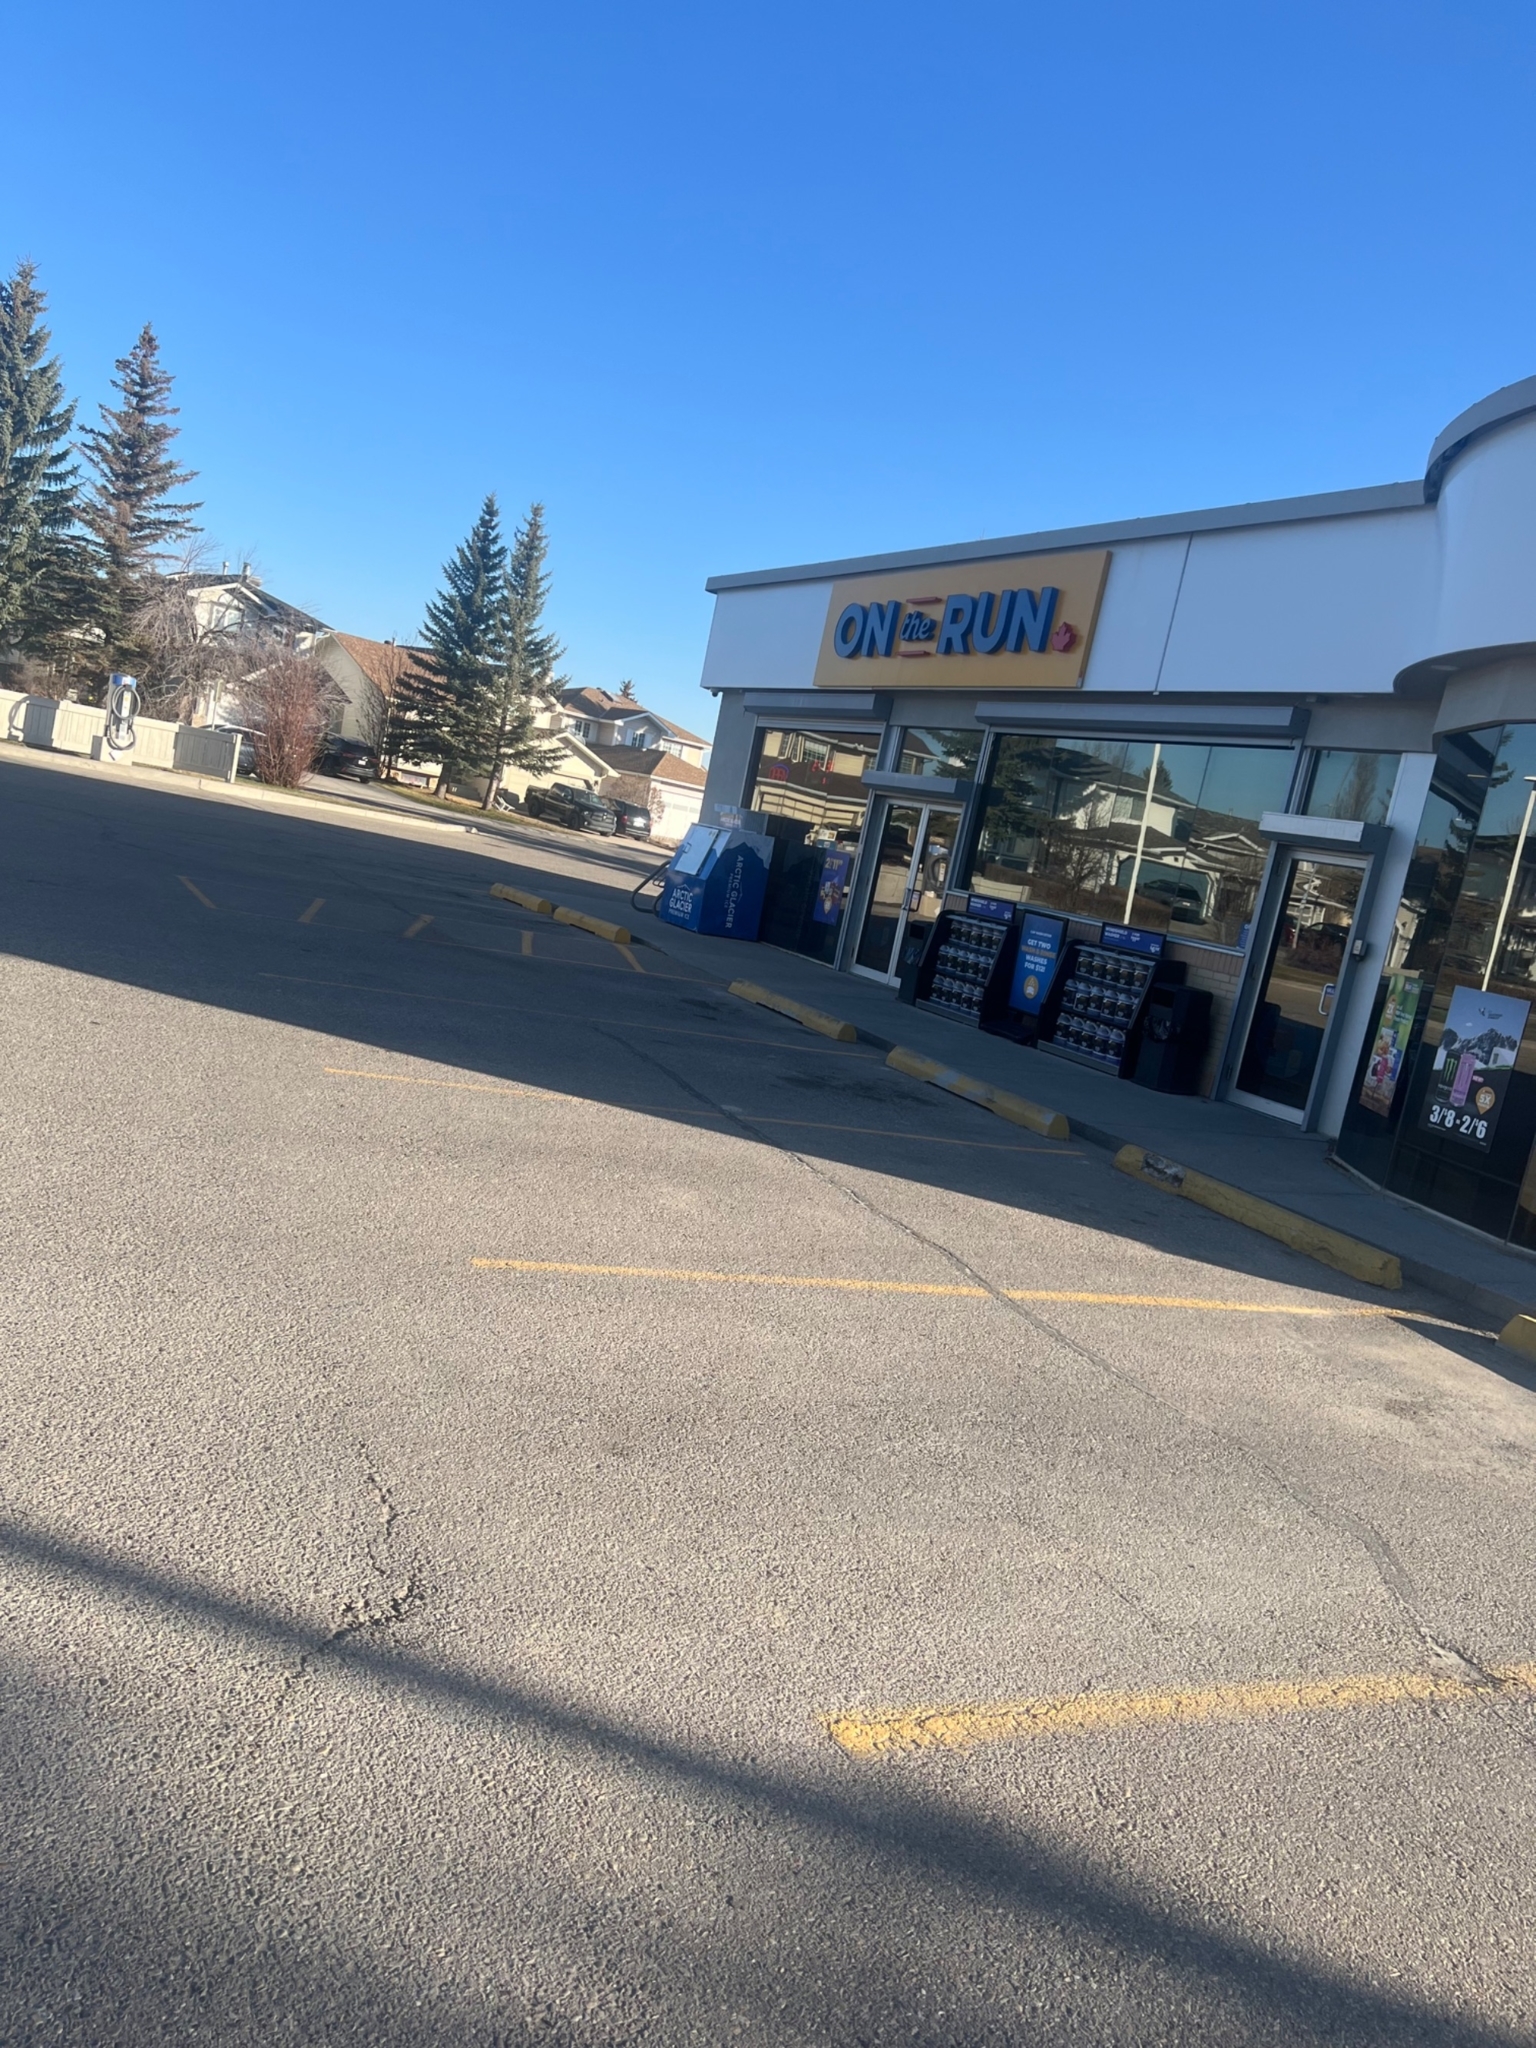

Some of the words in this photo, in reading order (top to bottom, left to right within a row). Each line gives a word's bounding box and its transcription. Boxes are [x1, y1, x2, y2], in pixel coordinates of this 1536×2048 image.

[834, 600, 901, 658] ON
[901, 610, 936, 641] the
[936, 587, 1060, 654] RUN
[732, 854, 744, 889] ARCTIC
[672, 888, 693, 902] ARCTIC
[669, 898, 692, 913] GLACIER
[725, 890, 738, 928] GLACIER
[1027, 938, 1037, 947] GET
[1038, 941, 1051, 950] TWO
[1024, 961, 1034, 970] FOR
[1025, 954, 1048, 965] WASHES
[1479, 1094, 1492, 1105] 5X
